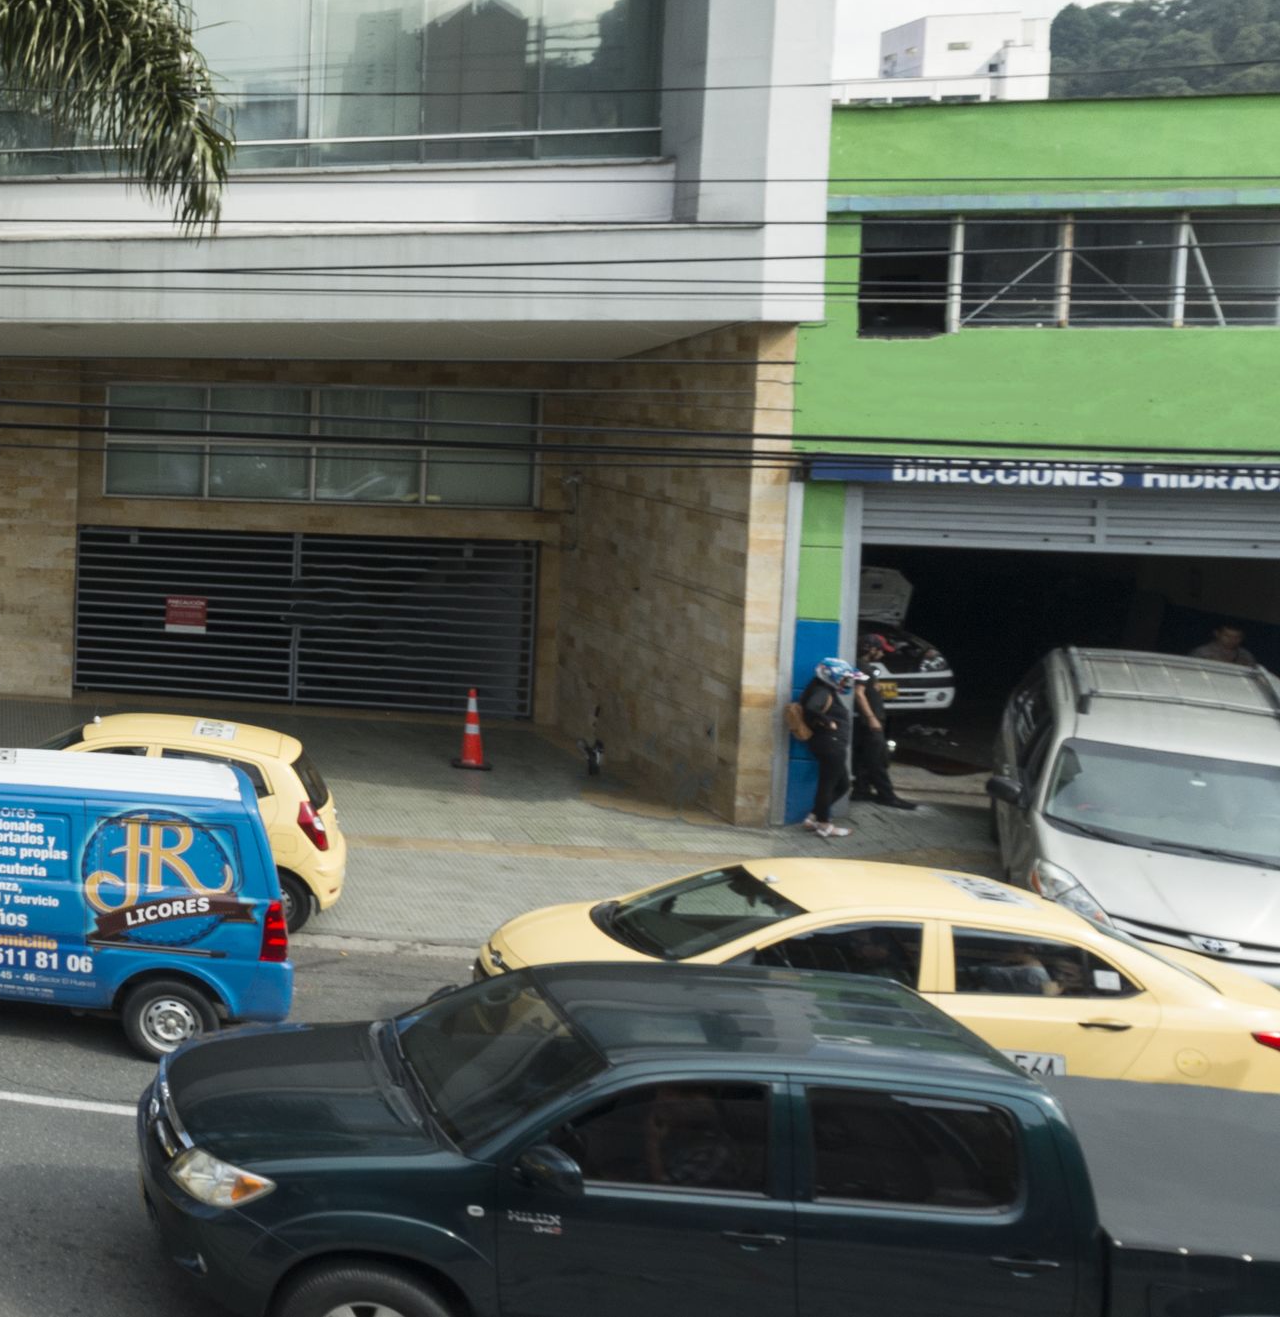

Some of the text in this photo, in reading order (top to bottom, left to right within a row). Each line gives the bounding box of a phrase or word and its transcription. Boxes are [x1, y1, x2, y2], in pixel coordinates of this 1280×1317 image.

[47, 836, 56, 850] y
[20, 846, 68, 861] propias
[4, 894, 11, 904] y
[14, 894, 59, 907] servicio
[126, 897, 210, 926] LICORES
[35, 951, 58, 970] 81
[67, 954, 93, 973] 06
[0, 970, 13, 980] 45
